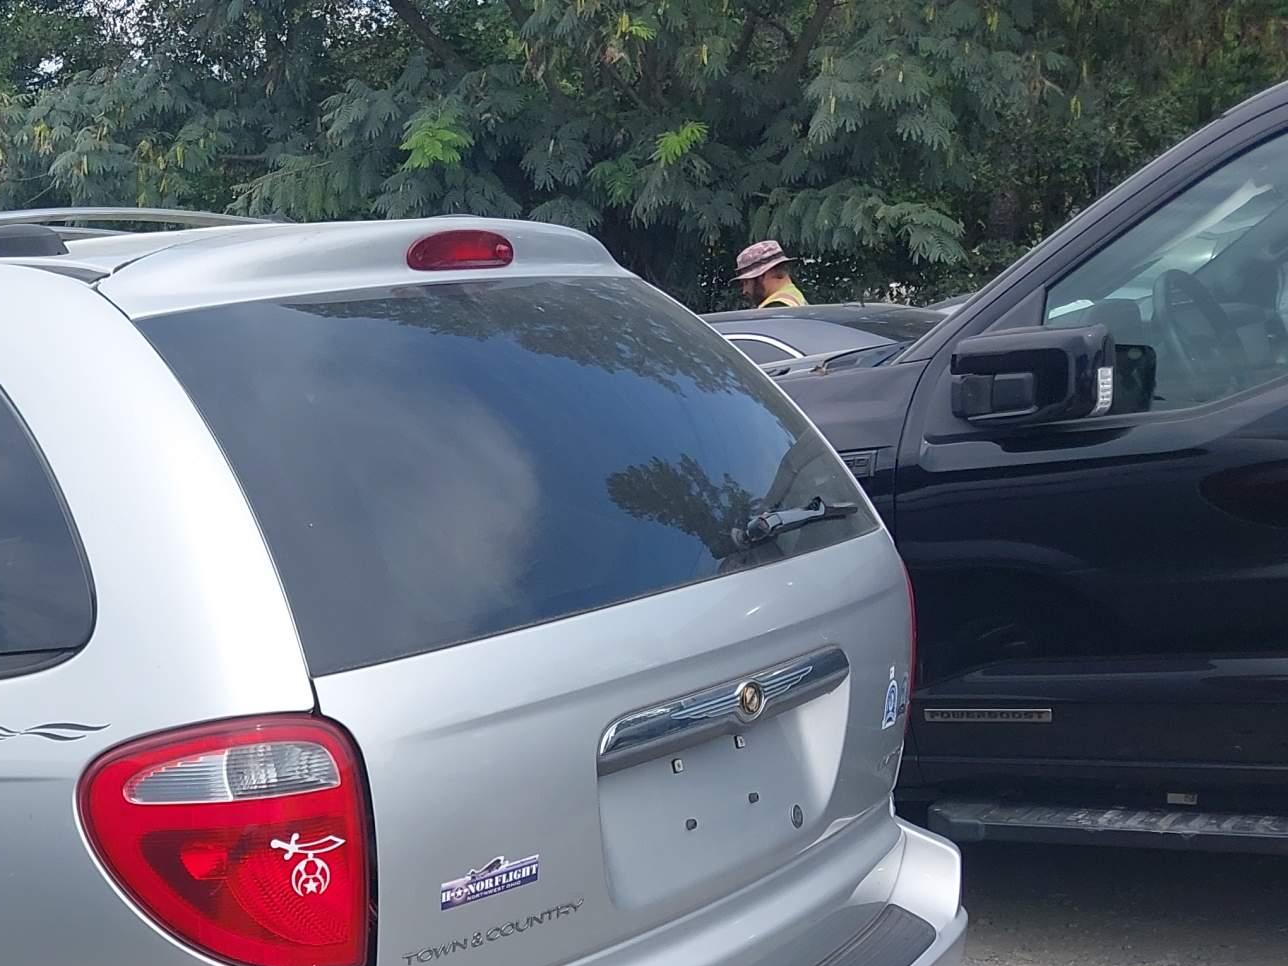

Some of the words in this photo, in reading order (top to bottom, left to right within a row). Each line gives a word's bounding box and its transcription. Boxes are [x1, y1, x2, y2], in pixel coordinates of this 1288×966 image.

[401, 938, 468, 966] TOWN
[471, 931, 484, 948] &
[486, 898, 585, 942] COUNTRY
